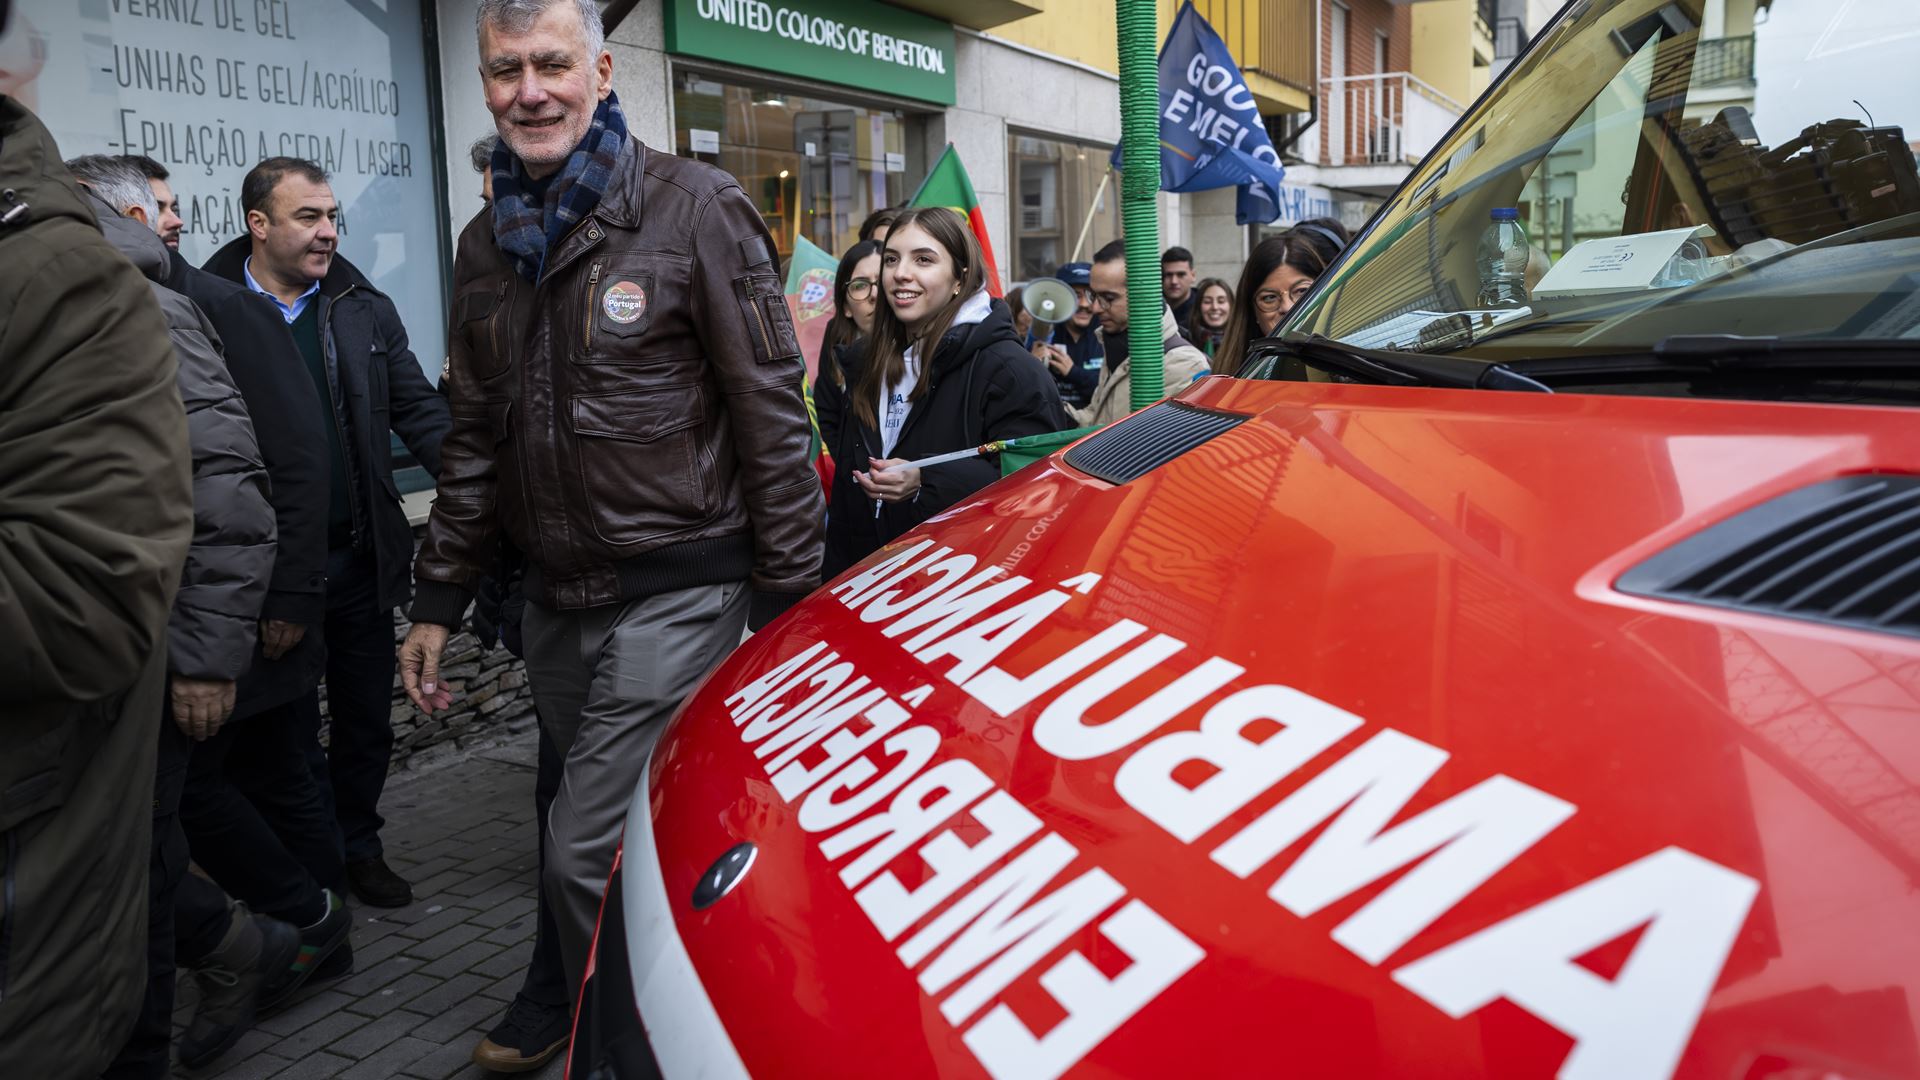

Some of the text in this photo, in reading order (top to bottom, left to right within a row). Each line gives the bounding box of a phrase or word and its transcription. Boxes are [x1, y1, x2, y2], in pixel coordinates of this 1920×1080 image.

[112, 0, 296, 41] NIZ DE GEL
[696, 0, 773, 33] UNITED
[775, 8, 846, 51] COLORS
[847, 27, 870, 55] OF
[216, 58, 248, 100] DE
[257, 60, 399, 117] GEL/ACRÍLICO
[1162, 88, 1195, 124] E
[355, 137, 412, 178] LASER
[608, 299, 642, 310] Portugal
